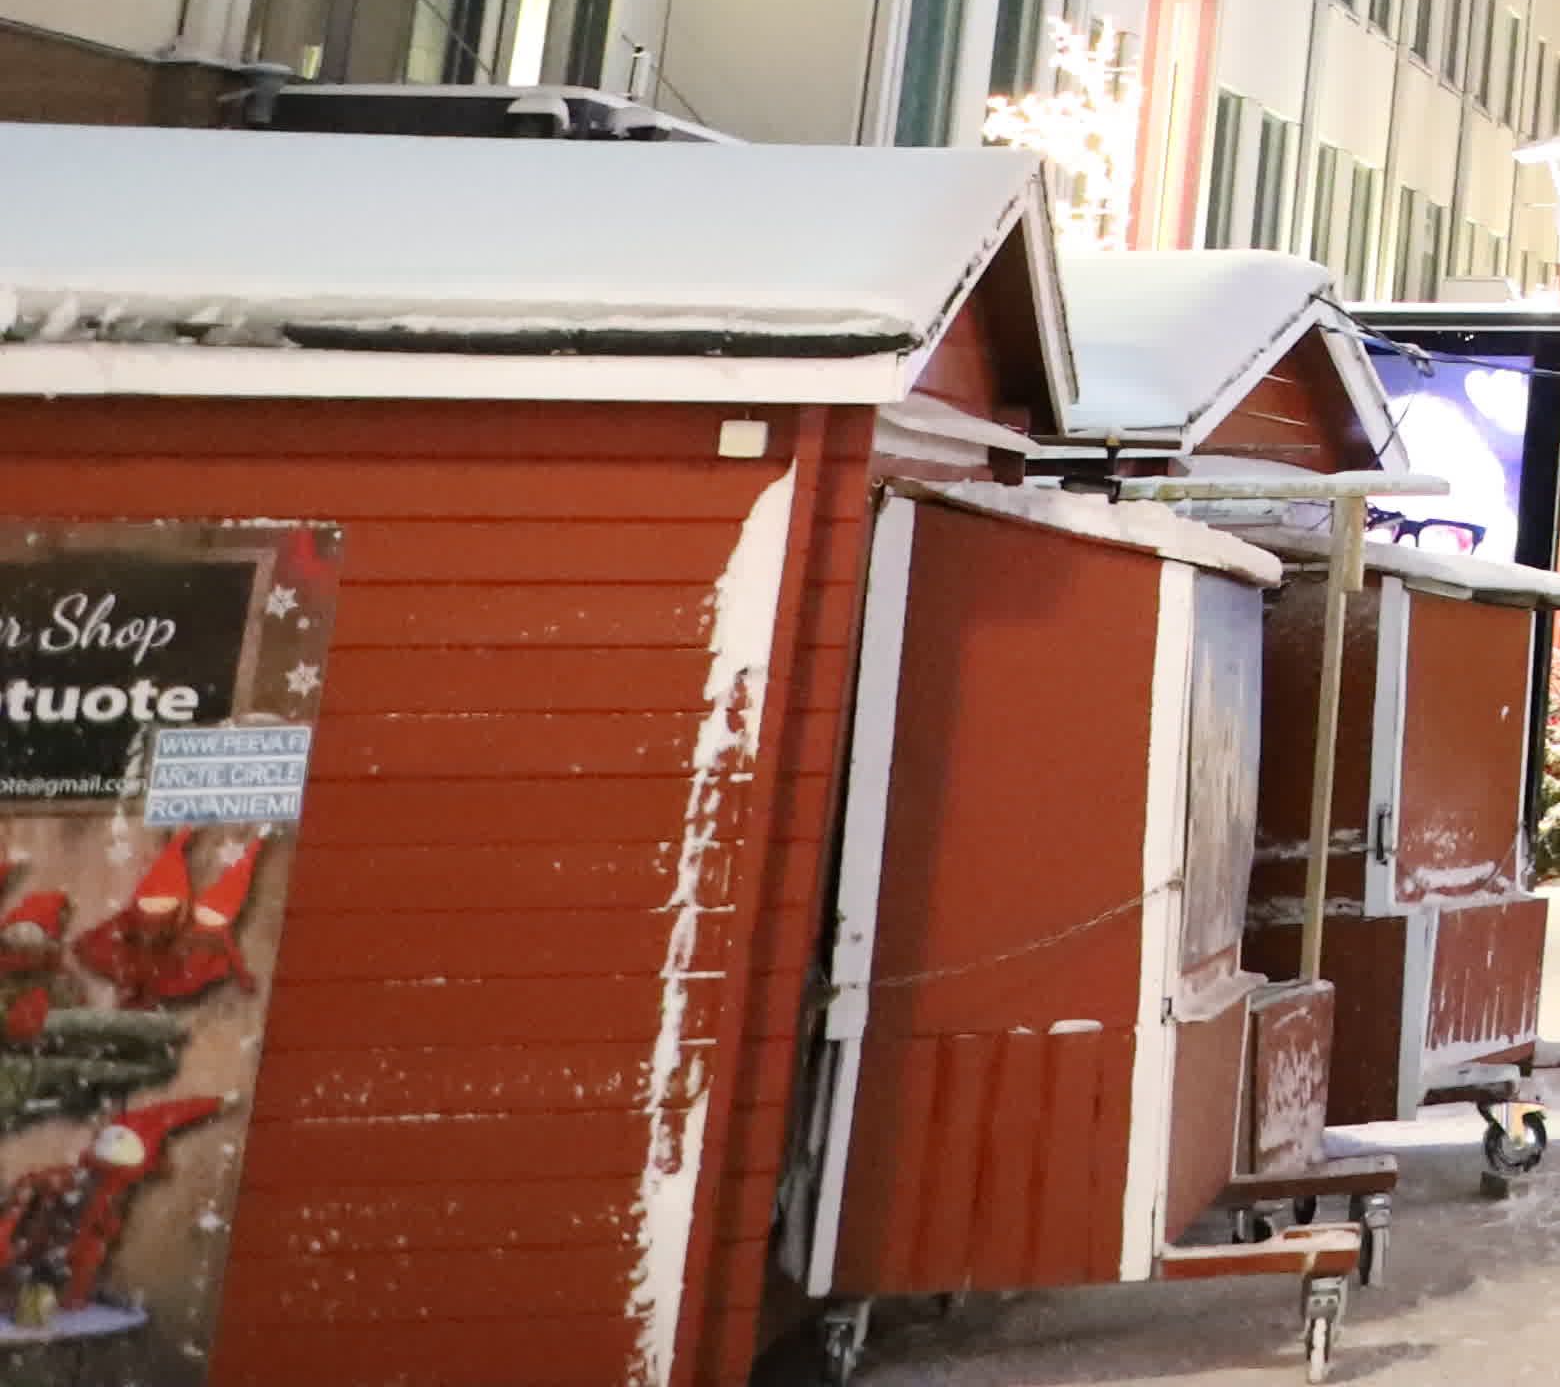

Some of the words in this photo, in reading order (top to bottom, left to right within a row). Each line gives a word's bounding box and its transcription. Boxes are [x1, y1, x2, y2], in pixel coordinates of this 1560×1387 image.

[0, 614, 29, 648] r
[40, 592, 176, 666] Shop
[0, 678, 200, 722] tuote
[155, 764, 224, 788] ARCTIC
[230, 762, 300, 785] CIRCLE
[149, 793, 297, 818] ROVANIEMI
